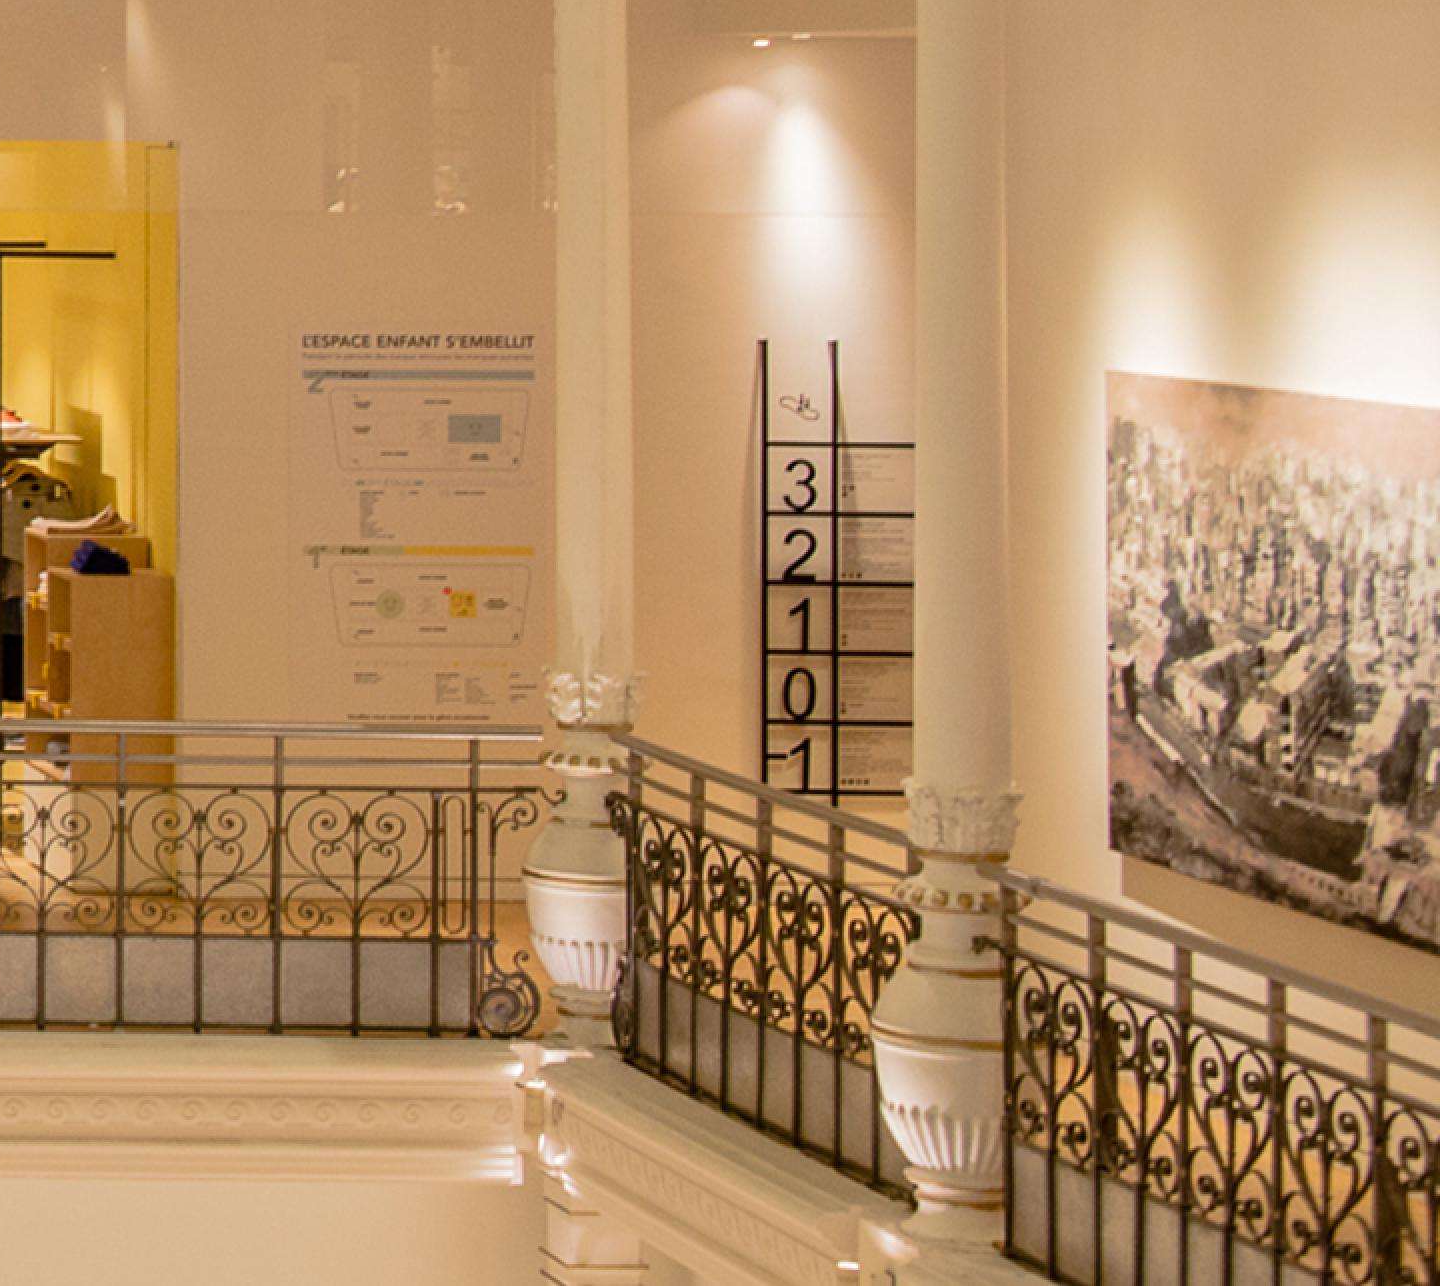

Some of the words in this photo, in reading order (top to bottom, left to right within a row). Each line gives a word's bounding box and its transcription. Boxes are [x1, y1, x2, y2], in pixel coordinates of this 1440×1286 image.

[302, 334, 371, 349] L'ESPACE
[375, 334, 441, 349] ENFANT
[445, 334, 536, 349] S'EMBELLIT
[783, 458, 818, 513] 3
[782, 528, 818, 583] 2
[788, 597, 811, 651] 1
[782, 666, 817, 721] 0
